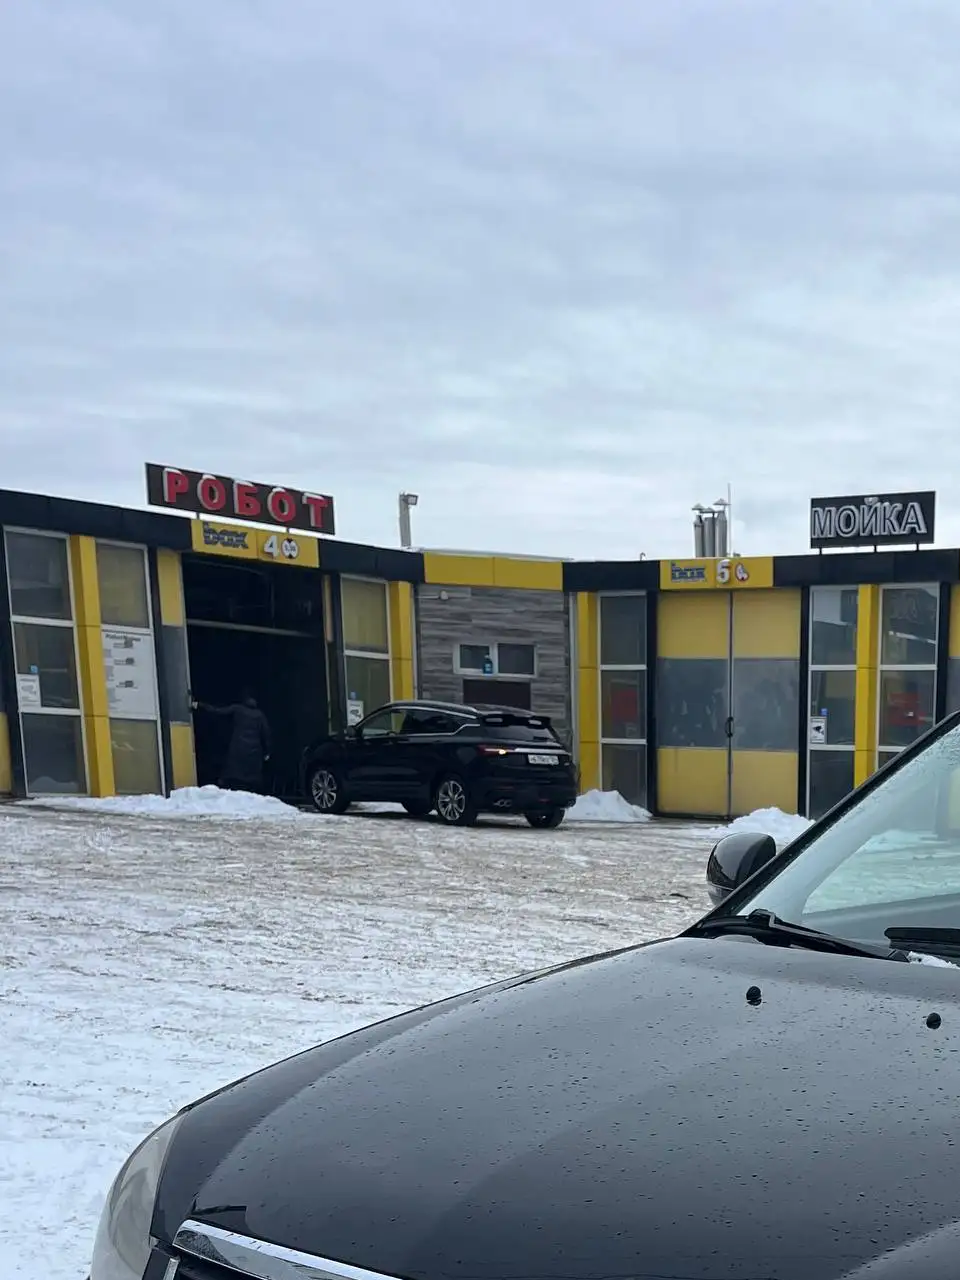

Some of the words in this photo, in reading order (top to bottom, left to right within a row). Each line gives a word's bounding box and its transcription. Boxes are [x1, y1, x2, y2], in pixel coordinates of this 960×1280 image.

[163, 468, 329, 528] РОБОТ
[811, 496, 928, 538] МОЙКА
[264, 534, 280, 559] 4
[716, 559, 732, 584] 5
